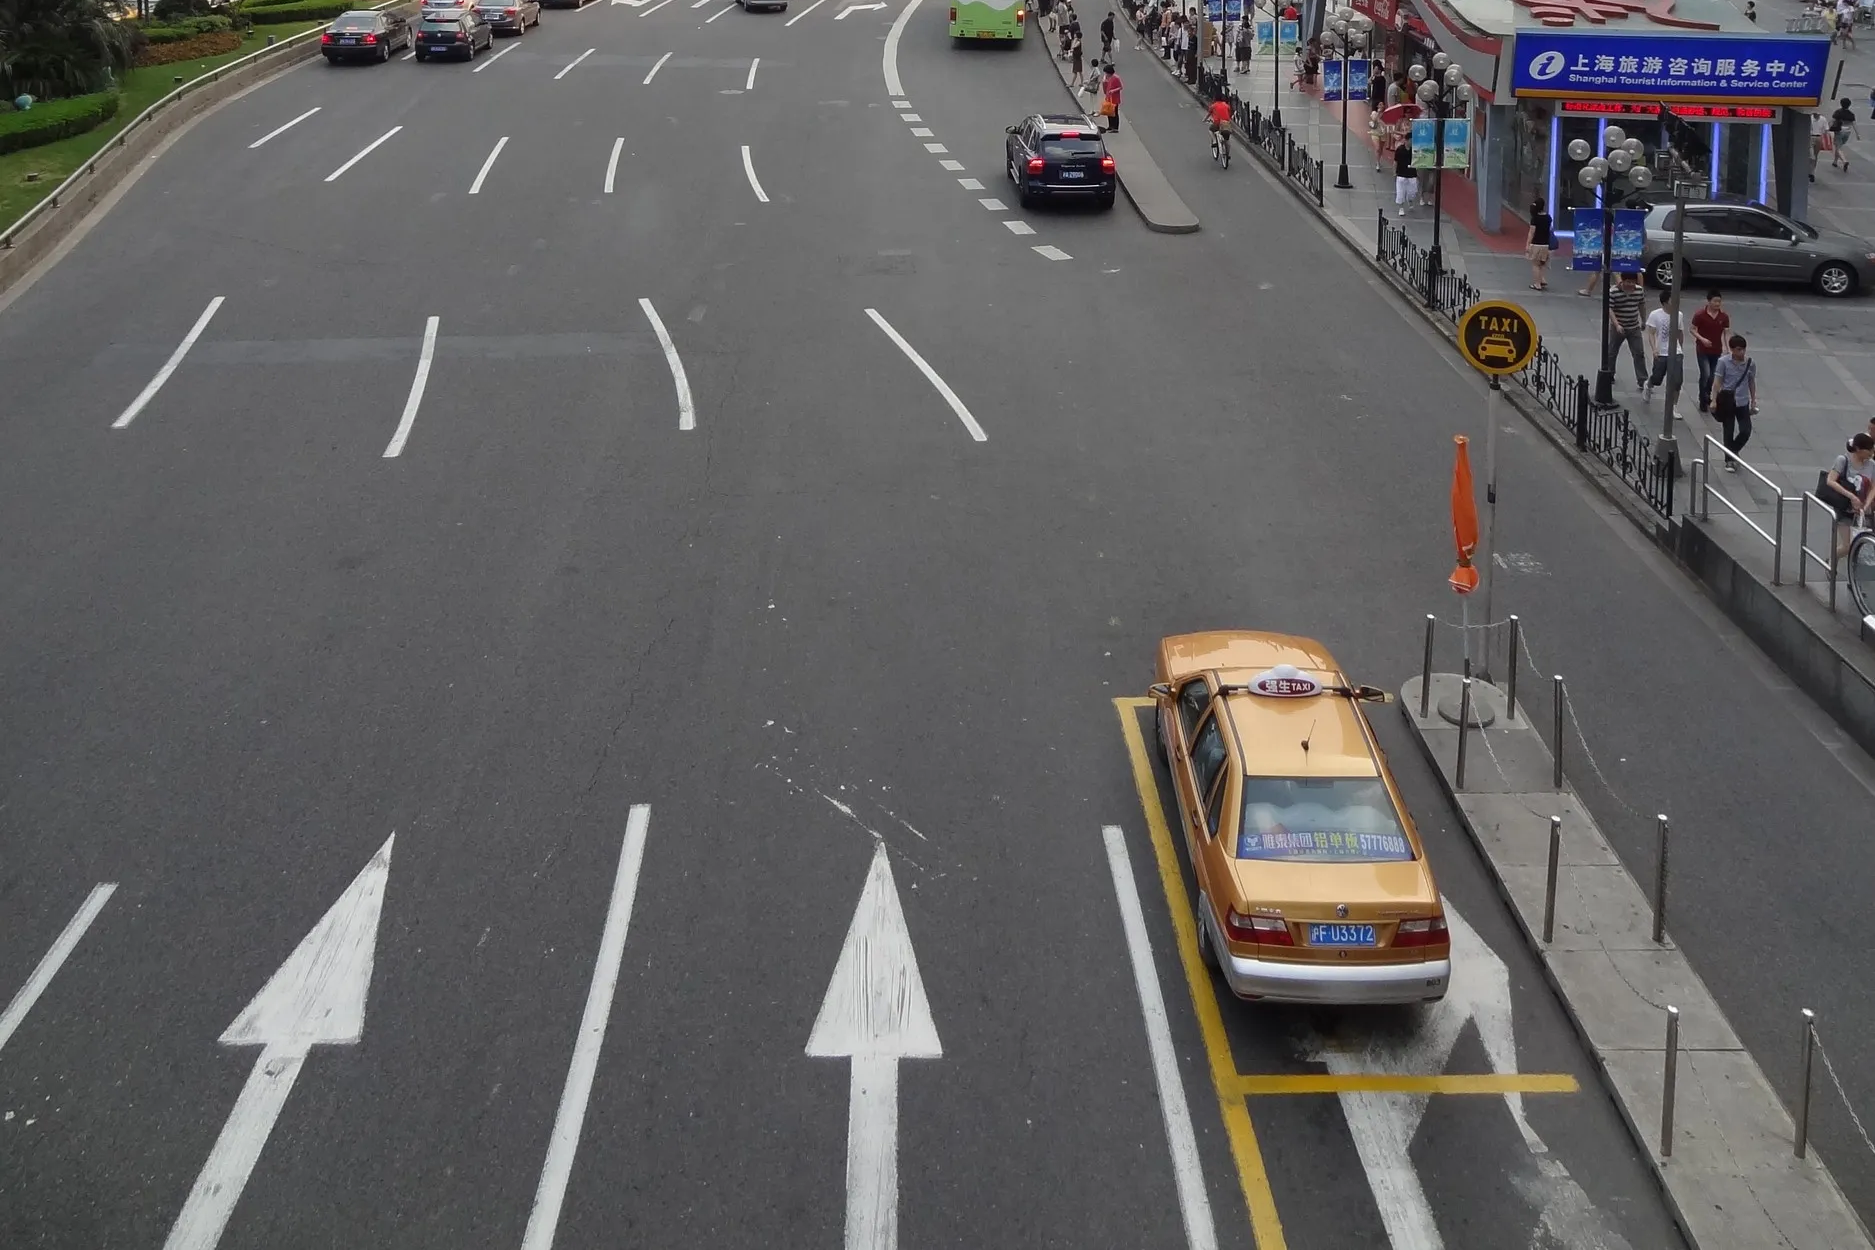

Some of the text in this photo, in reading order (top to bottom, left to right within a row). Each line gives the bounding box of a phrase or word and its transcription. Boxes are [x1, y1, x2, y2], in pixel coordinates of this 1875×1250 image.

[1570, 54, 1811, 77] 上海旅游咨询服务中心
[1569, 74, 1808, 88] Shanghai Tourist Information & Service Center
[1479, 315, 1518, 333] TAXI
[1265, 679, 1311, 693] 强生 TAXI
[1314, 832, 1359, 849] 铝单板
[1360, 834, 1405, 853] 57776888
